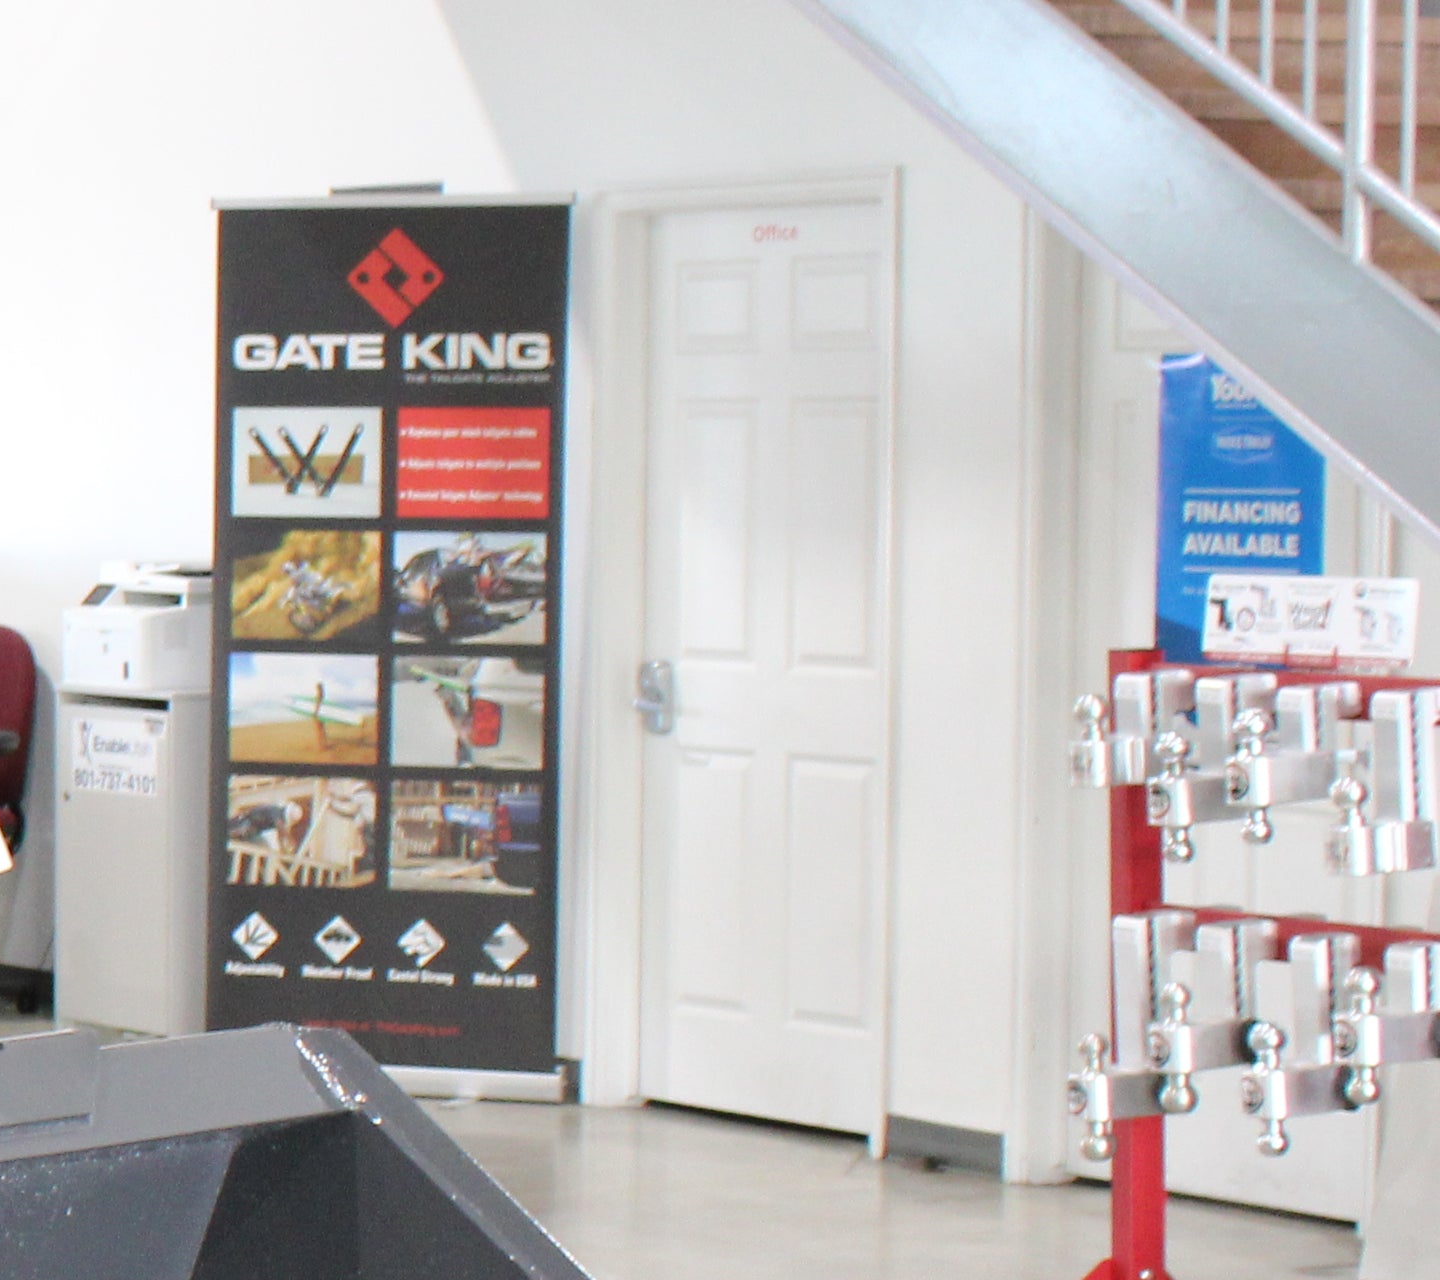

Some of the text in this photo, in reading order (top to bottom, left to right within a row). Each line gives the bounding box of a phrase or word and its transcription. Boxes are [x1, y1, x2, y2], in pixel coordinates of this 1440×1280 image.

[233, 332, 551, 371] GATE KING
[1183, 500, 1302, 526] FINANCING
[1183, 532, 1300, 558] AVAILABLE
[473, 972, 503, 986] Made
[515, 974, 538, 988] USA
